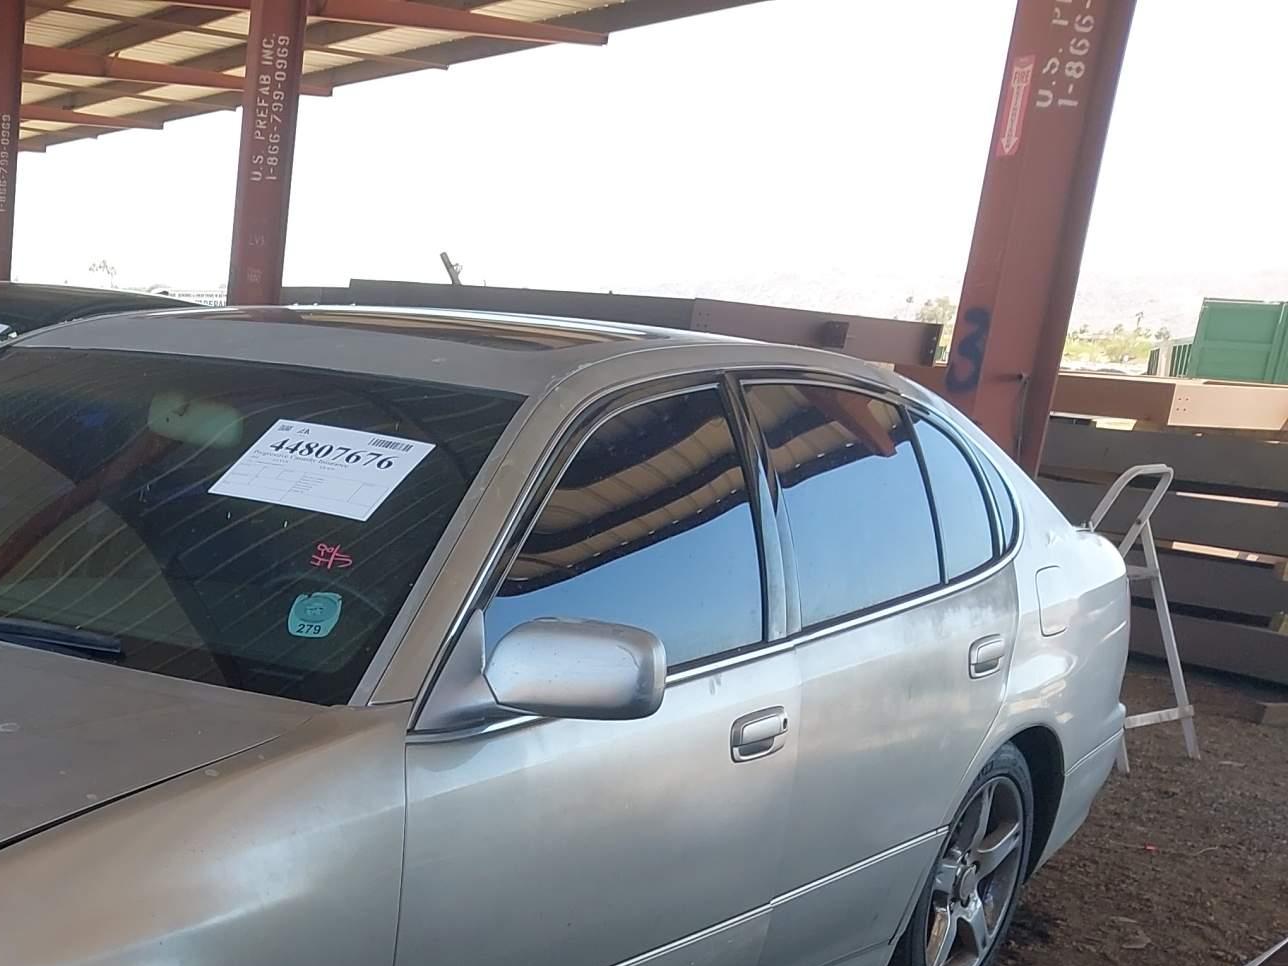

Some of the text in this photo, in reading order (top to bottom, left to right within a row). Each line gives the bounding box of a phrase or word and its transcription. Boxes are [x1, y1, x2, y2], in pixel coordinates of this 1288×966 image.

[261, 33, 276, 65] INC.
[1035, 48, 1060, 107] U.S.
[254, 74, 271, 140] PREFAB
[265, 35, 290, 181] 1-866-799-0969
[270, 438, 399, 470] 44807676
[296, 623, 322, 635] 279
